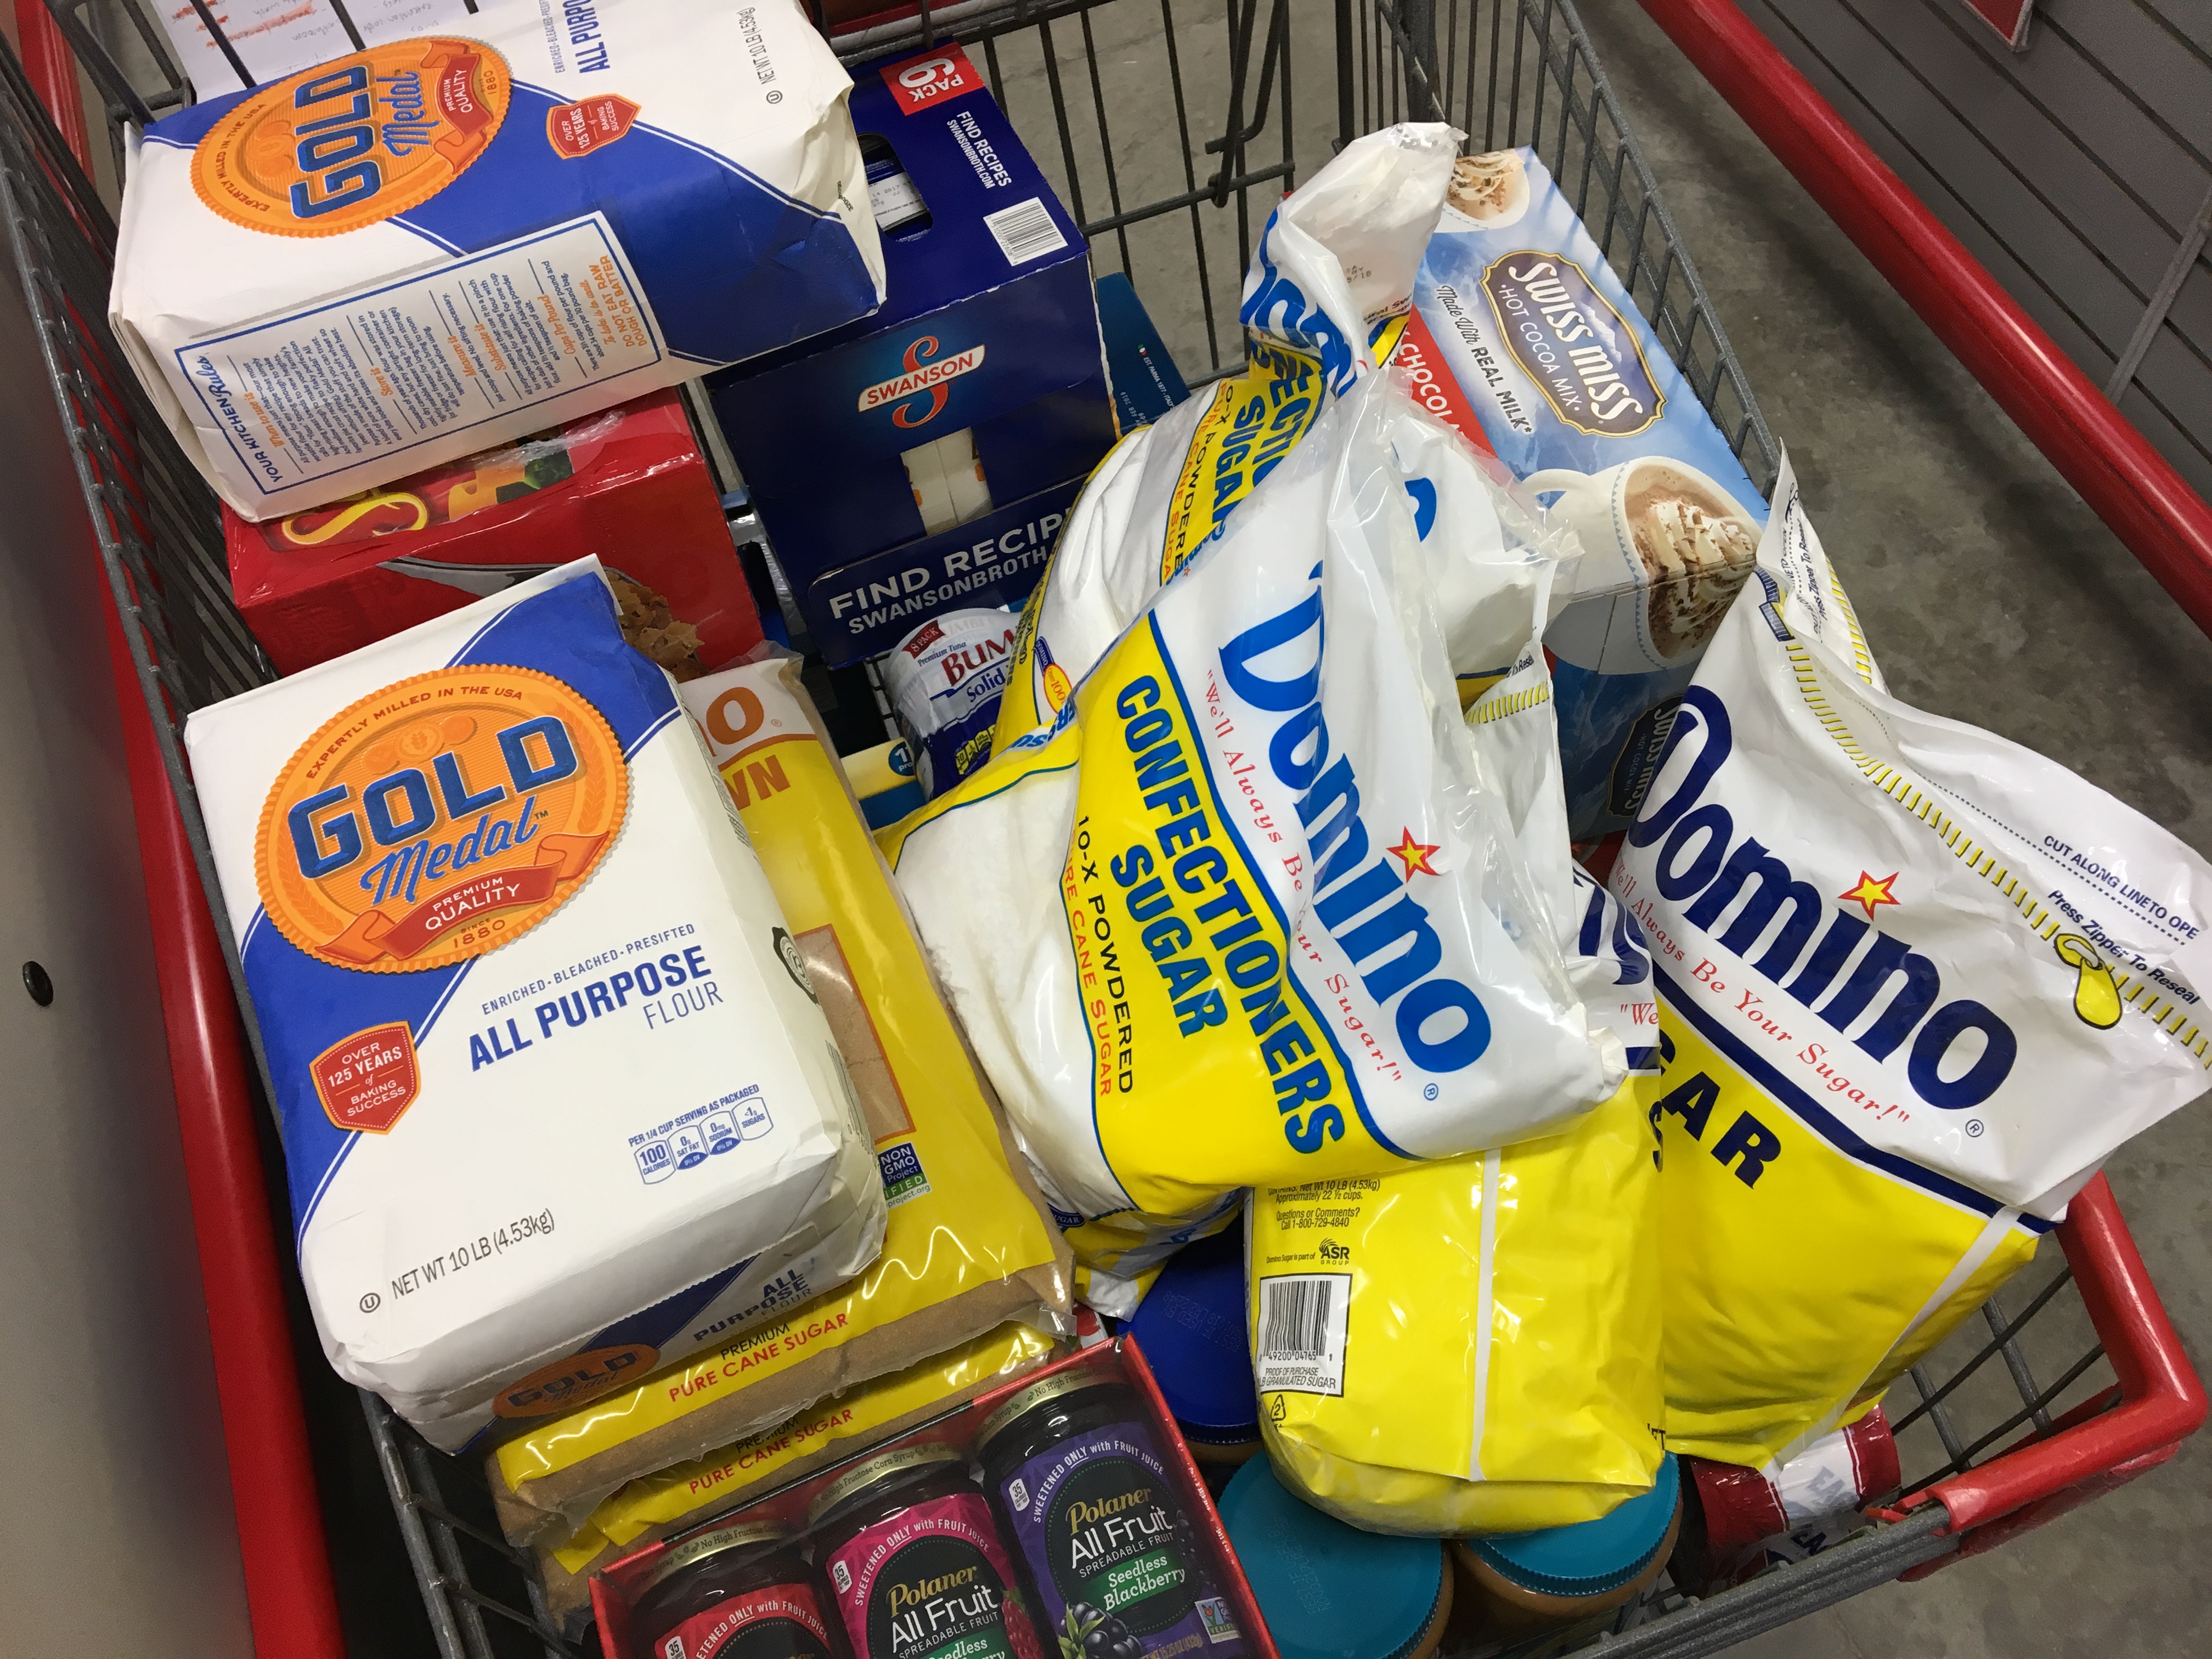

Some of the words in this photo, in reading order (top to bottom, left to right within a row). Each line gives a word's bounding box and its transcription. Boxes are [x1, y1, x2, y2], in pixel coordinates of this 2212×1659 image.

[575, 41, 611, 73] ALL
[483, 70, 498, 95] 1880
[912, 74, 964, 103] PACK
[376, 71, 441, 157] Medal
[289, 64, 381, 218] GOLD
[947, 119, 996, 190] SWANSONBROTH.COM
[957, 111, 980, 139] FIND
[973, 137, 1012, 187] RECIPES
[588, 261, 607, 290] RAW
[599, 253, 624, 297] BATTER
[538, 292, 560, 324] Pound
[602, 291, 618, 312] EAT
[619, 297, 633, 314] OR
[552, 320, 566, 336] Per
[611, 312, 628, 334] NOT
[622, 332, 634, 348] DO
[627, 314, 647, 346] DOUGH
[1436, 285, 1462, 318] Made
[1455, 314, 1482, 346] With
[1471, 346, 1498, 388] REAL
[1508, 261, 1594, 343] SWISS
[1568, 342, 1643, 420] MISS
[451, 342, 476, 378] Measure
[478, 331, 506, 373] Substitute
[558, 333, 577, 355] Cups
[1499, 287, 1530, 320] HOT
[1520, 321, 1562, 375] COCOA
[1551, 376, 1582, 409] MIX
[193, 356, 231, 403] Rules
[866, 349, 974, 408] SWANSON
[218, 395, 260, 451] KITCHEN
[250, 399, 264, 416] use
[258, 415, 270, 428] to
[264, 425, 284, 449] When
[255, 450, 283, 483] YOUR
[828, 567, 930, 620] FIND
[848, 545, 1047, 636] SWANSONBROTH
[910, 643, 921, 653] 8
[918, 627, 939, 647] PACK
[917, 649, 948, 667] Premium
[947, 641, 967, 652] Tuna
[967, 667, 1006, 703] Solid
[304, 718, 371, 779] EXPERTLY
[373, 691, 432, 722] MILLED
[438, 687, 455, 698] IN
[461, 685, 490, 696] THE
[495, 687, 524, 701] USA
[287, 715, 579, 879] GOLD
[1218, 560, 1492, 1074] Domino
[359, 796, 538, 906] Medal
[1076, 815, 1100, 884] 10-X
[2044, 835, 2073, 857] CUT
[2070, 854, 2120, 888] ALONG
[424, 881, 522, 932] QUALITY
[432, 876, 505, 912] PREMIUM
[1628, 685, 2018, 1110] Domino
[452, 919, 507, 949] 1880
[1115, 674, 1347, 1155] CONFECTIONERS
[1222, 748, 1283, 845] Always
[1282, 850, 1304, 893] Be
[1323, 974, 1404, 1085] Sugar!"
[1109, 843, 1229, 1041] SUGAR
[2047, 889, 2084, 924] Press
[2081, 919, 2130, 958] Zipper
[2129, 953, 2147, 972] To
[2148, 968, 2200, 1006] Reseal
[468, 1022, 534, 1072] ALL
[536, 944, 713, 1040] PURPOSE
[642, 981, 724, 1030] FLOUR
[1071, 909, 1098, 990] CANE
[1090, 998, 1113, 1098] SUGAR
[1087, 895, 1135, 1095] POWDERED
[1630, 898, 1686, 962] Always
[1690, 958, 1727, 994] Be
[1733, 986, 1794, 1045] Your
[1795, 1041, 1912, 1125] Sugar!"
[328, 1065, 353, 1088] 125
[354, 1043, 404, 1077] YEARS
[341, 1042, 381, 1065] OVER
[346, 1086, 407, 1118] SUCCESS
[350, 1079, 398, 1105] BAKING
[628, 1133, 645, 1147] PER
[646, 1129, 658, 1140] 1/4
[658, 1121, 674, 1135] CUP
[674, 1105, 708, 1127] SERVING
[709, 1101, 720, 1113] AS
[720, 1084, 760, 1107] PACKAGED
[708, 1127, 733, 1142] SODIUM
[741, 1113, 766, 1128] SUGARS
[639, 1144, 667, 1166] 100
[642, 1159, 671, 1175] CALORIES
[880, 1146, 912, 1167] NON
[885, 1154, 916, 1175] GMO
[887, 1164, 919, 1184] Project
[1275, 1191, 1322, 1205] Approximately
[1322, 1190, 1333, 1200] 22
[1342, 1191, 1363, 1201] cups.
[1276, 1209, 1305, 1222] Questions
[1306, 1209, 1313, 1218] or
[1315, 1207, 1361, 1218] Comments?
[1281, 1220, 1290, 1231] Call
[1292, 1217, 1350, 1229] 1-800-729-4840
[391, 1268, 420, 1300] NET
[421, 1256, 446, 1283] WT
[449, 1247, 470, 1272] 10
[471, 1237, 492, 1262] LB
[493, 1208, 555, 1255] (4.53kg)
[1319, 1246, 1350, 1260] ASR
[669, 1370, 719, 1402] PURE
[722, 1343, 780, 1378] CANE
[783, 1312, 849, 1351] SUGAR
[720, 1322, 791, 1361] PREMIUM
[1268, 1352, 1292, 1362] 49200
[1294, 1351, 1317, 1362] 04765
[1265, 1367, 1282, 1376] PROOF
[1282, 1367, 1290, 1376] OF
[1290, 1367, 1319, 1376] PURCHASE
[1265, 1375, 1306, 1387] GRANULATED
[1306, 1377, 1336, 1389] SUGAR
[843, 1465, 874, 1485] Fructose
[873, 1458, 894, 1470] Corn
[892, 1449, 916, 1464] Syrup
[1033, 1464, 1065, 1523] SWEETENED
[1064, 1446, 1087, 1467] ONLY
[1090, 1441, 1111, 1454] with
[1114, 1440, 1139, 1457] FRUIT
[1141, 1452, 1164, 1475] JUICE
[1065, 1487, 1153, 1536] Polaner
[1071, 1527, 1105, 1569] All
[1103, 1505, 1173, 1548] Fruit
[1079, 1541, 1146, 1578] SPREADABLE
[1148, 1532, 1175, 1547] FRUIT
[1103, 1568, 1186, 1611] Blackberry
[1108, 1555, 1168, 1588] Seedless
[885, 1566, 978, 1618] Polaner
